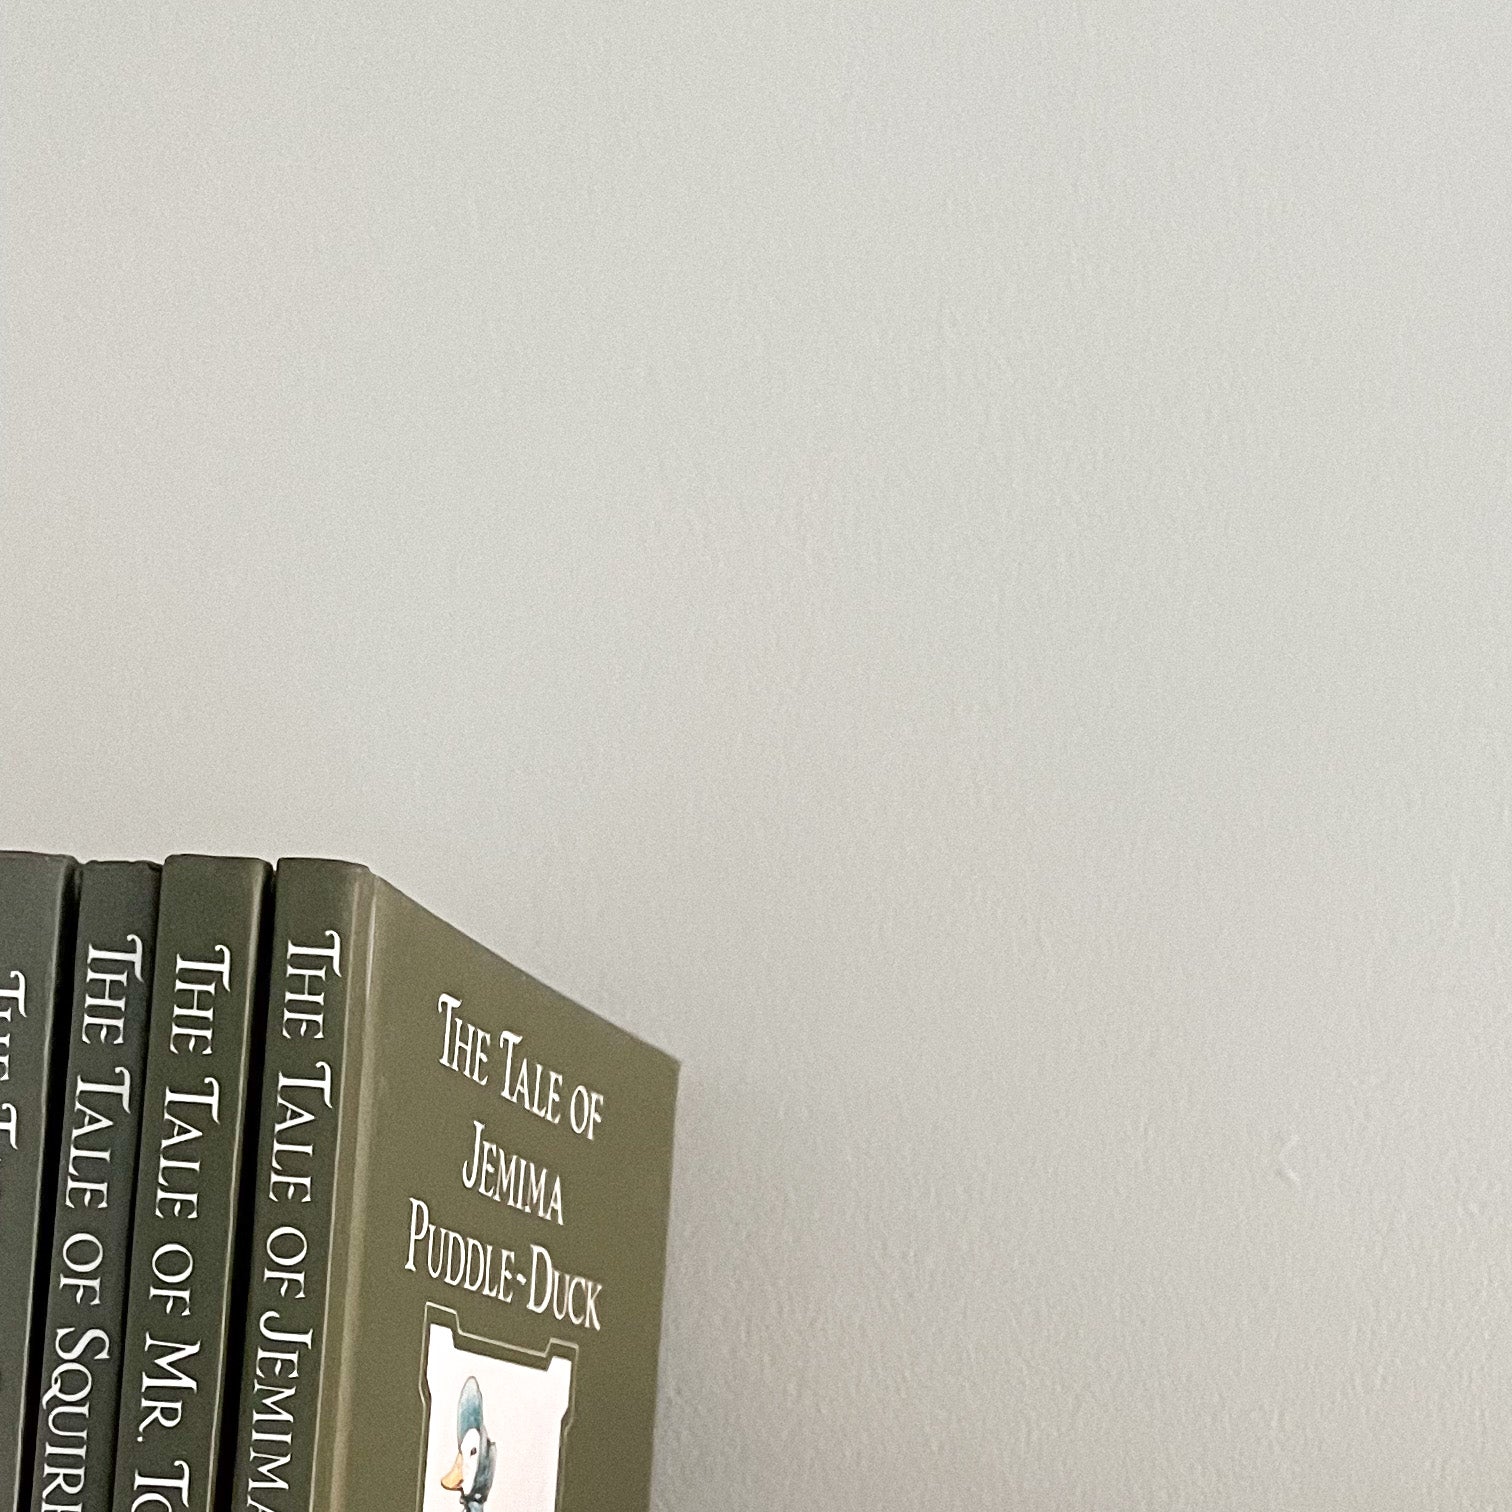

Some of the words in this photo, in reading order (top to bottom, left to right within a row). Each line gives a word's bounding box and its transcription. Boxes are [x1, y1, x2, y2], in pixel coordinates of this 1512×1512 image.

[81, 934, 143, 1045] THE
[169, 944, 231, 1056] THE
[282, 929, 342, 1039] THE
[438, 993, 491, 1086] THE
[500, 1031, 563, 1124] TALE
[570, 1085, 604, 1141] OF
[65, 1066, 131, 1209] TALE
[155, 1077, 220, 1220] TALE
[268, 1061, 333, 1203] TALE
[462, 1120, 564, 1226] JEMIMA
[59, 1233, 104, 1306] OF
[149, 1243, 193, 1317] OF
[263, 1226, 309, 1299] OF
[405, 1197, 603, 1332] PUDDLE-DUCK
[136, 1331, 201, 1444] MR.
